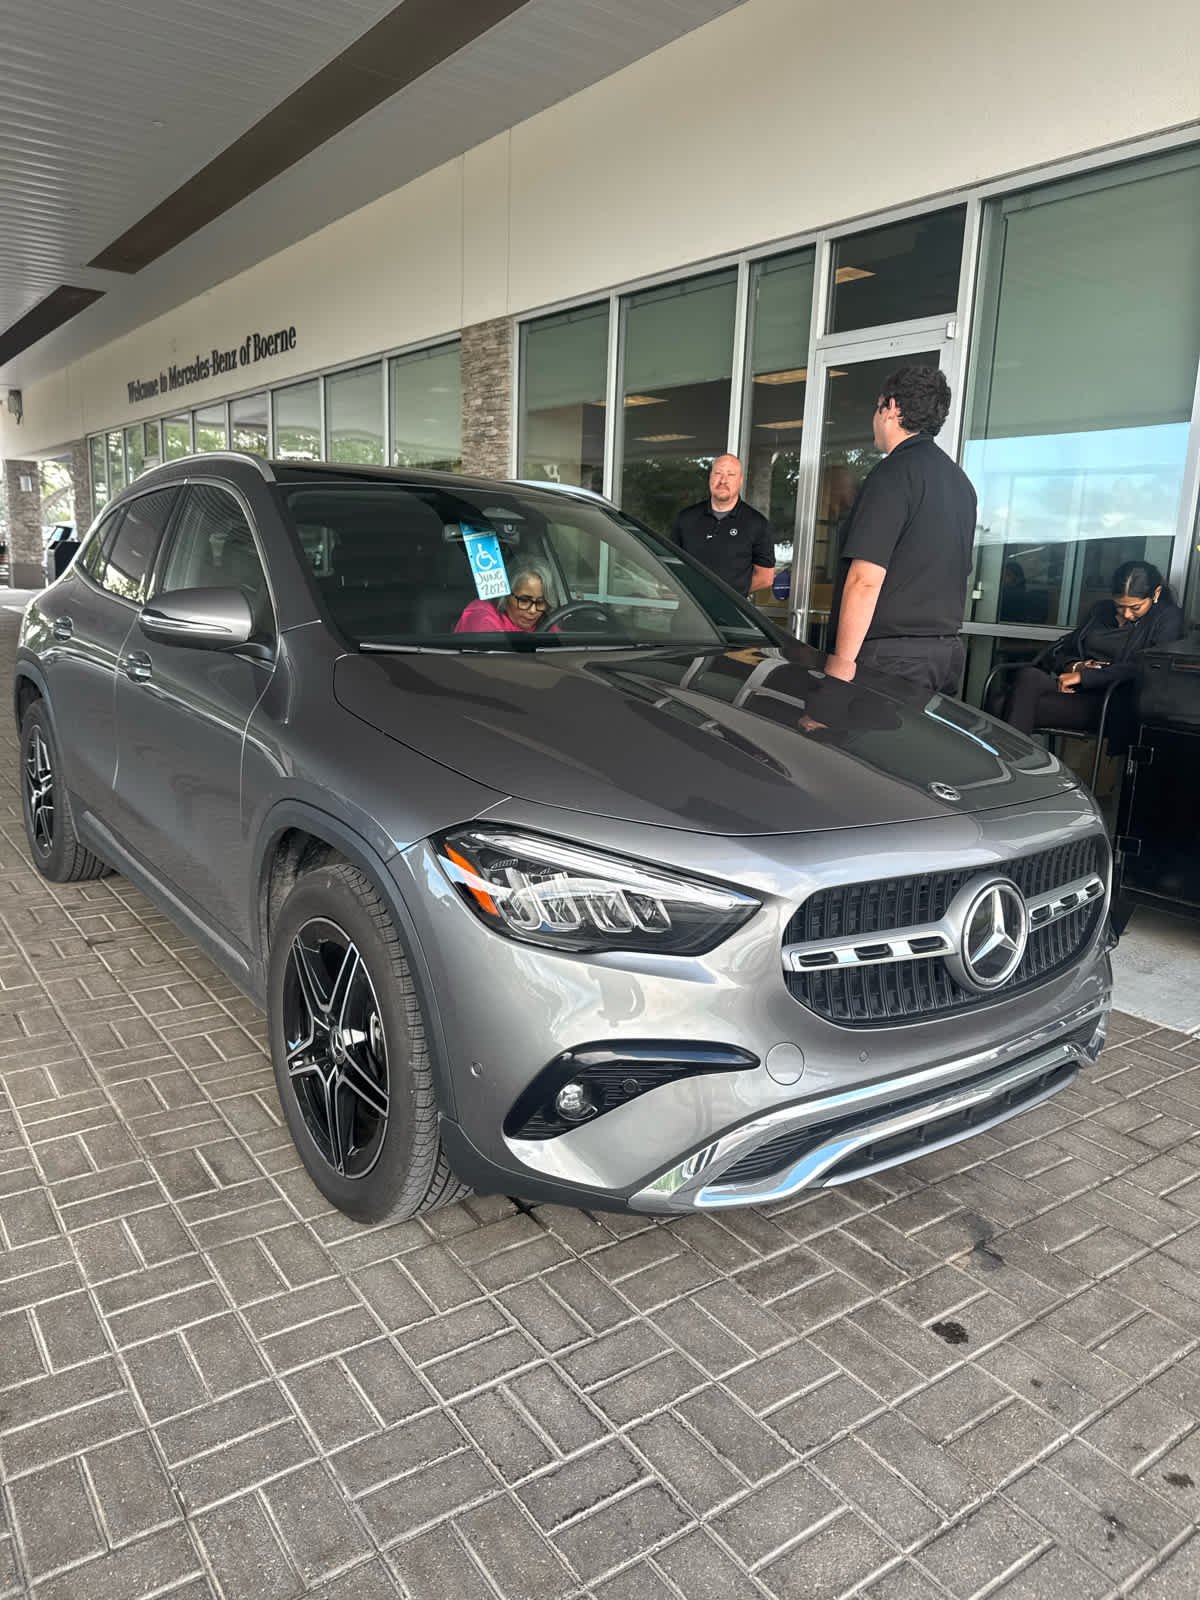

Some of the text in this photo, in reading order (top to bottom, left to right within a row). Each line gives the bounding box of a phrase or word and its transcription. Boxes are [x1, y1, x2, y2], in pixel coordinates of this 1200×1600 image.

[127, 326, 297, 404] Welcome to Mercedes-Benz of Boerne
